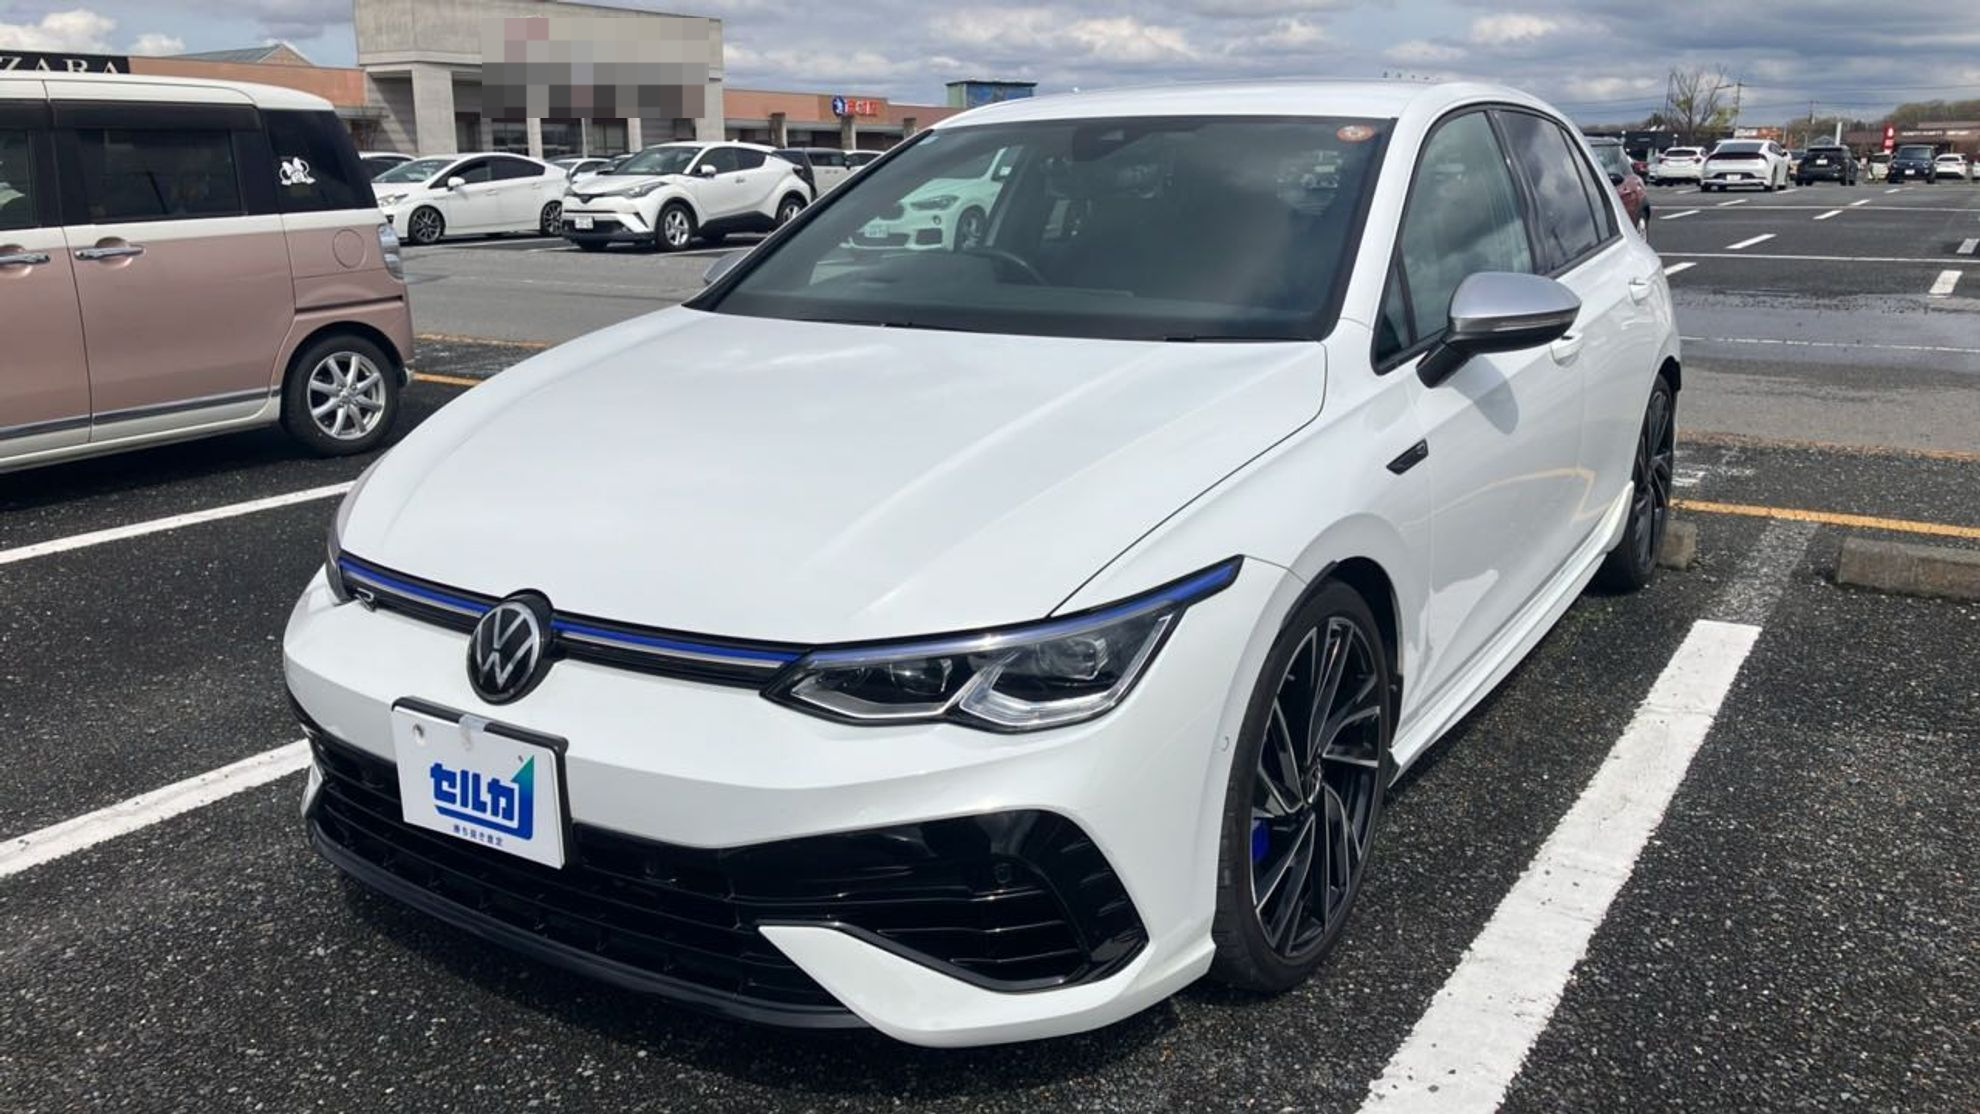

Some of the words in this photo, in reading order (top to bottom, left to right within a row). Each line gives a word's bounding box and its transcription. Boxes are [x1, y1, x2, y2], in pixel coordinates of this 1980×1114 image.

[0, 56, 119, 73] ZARA
[430, 762, 515, 822] セルカ
